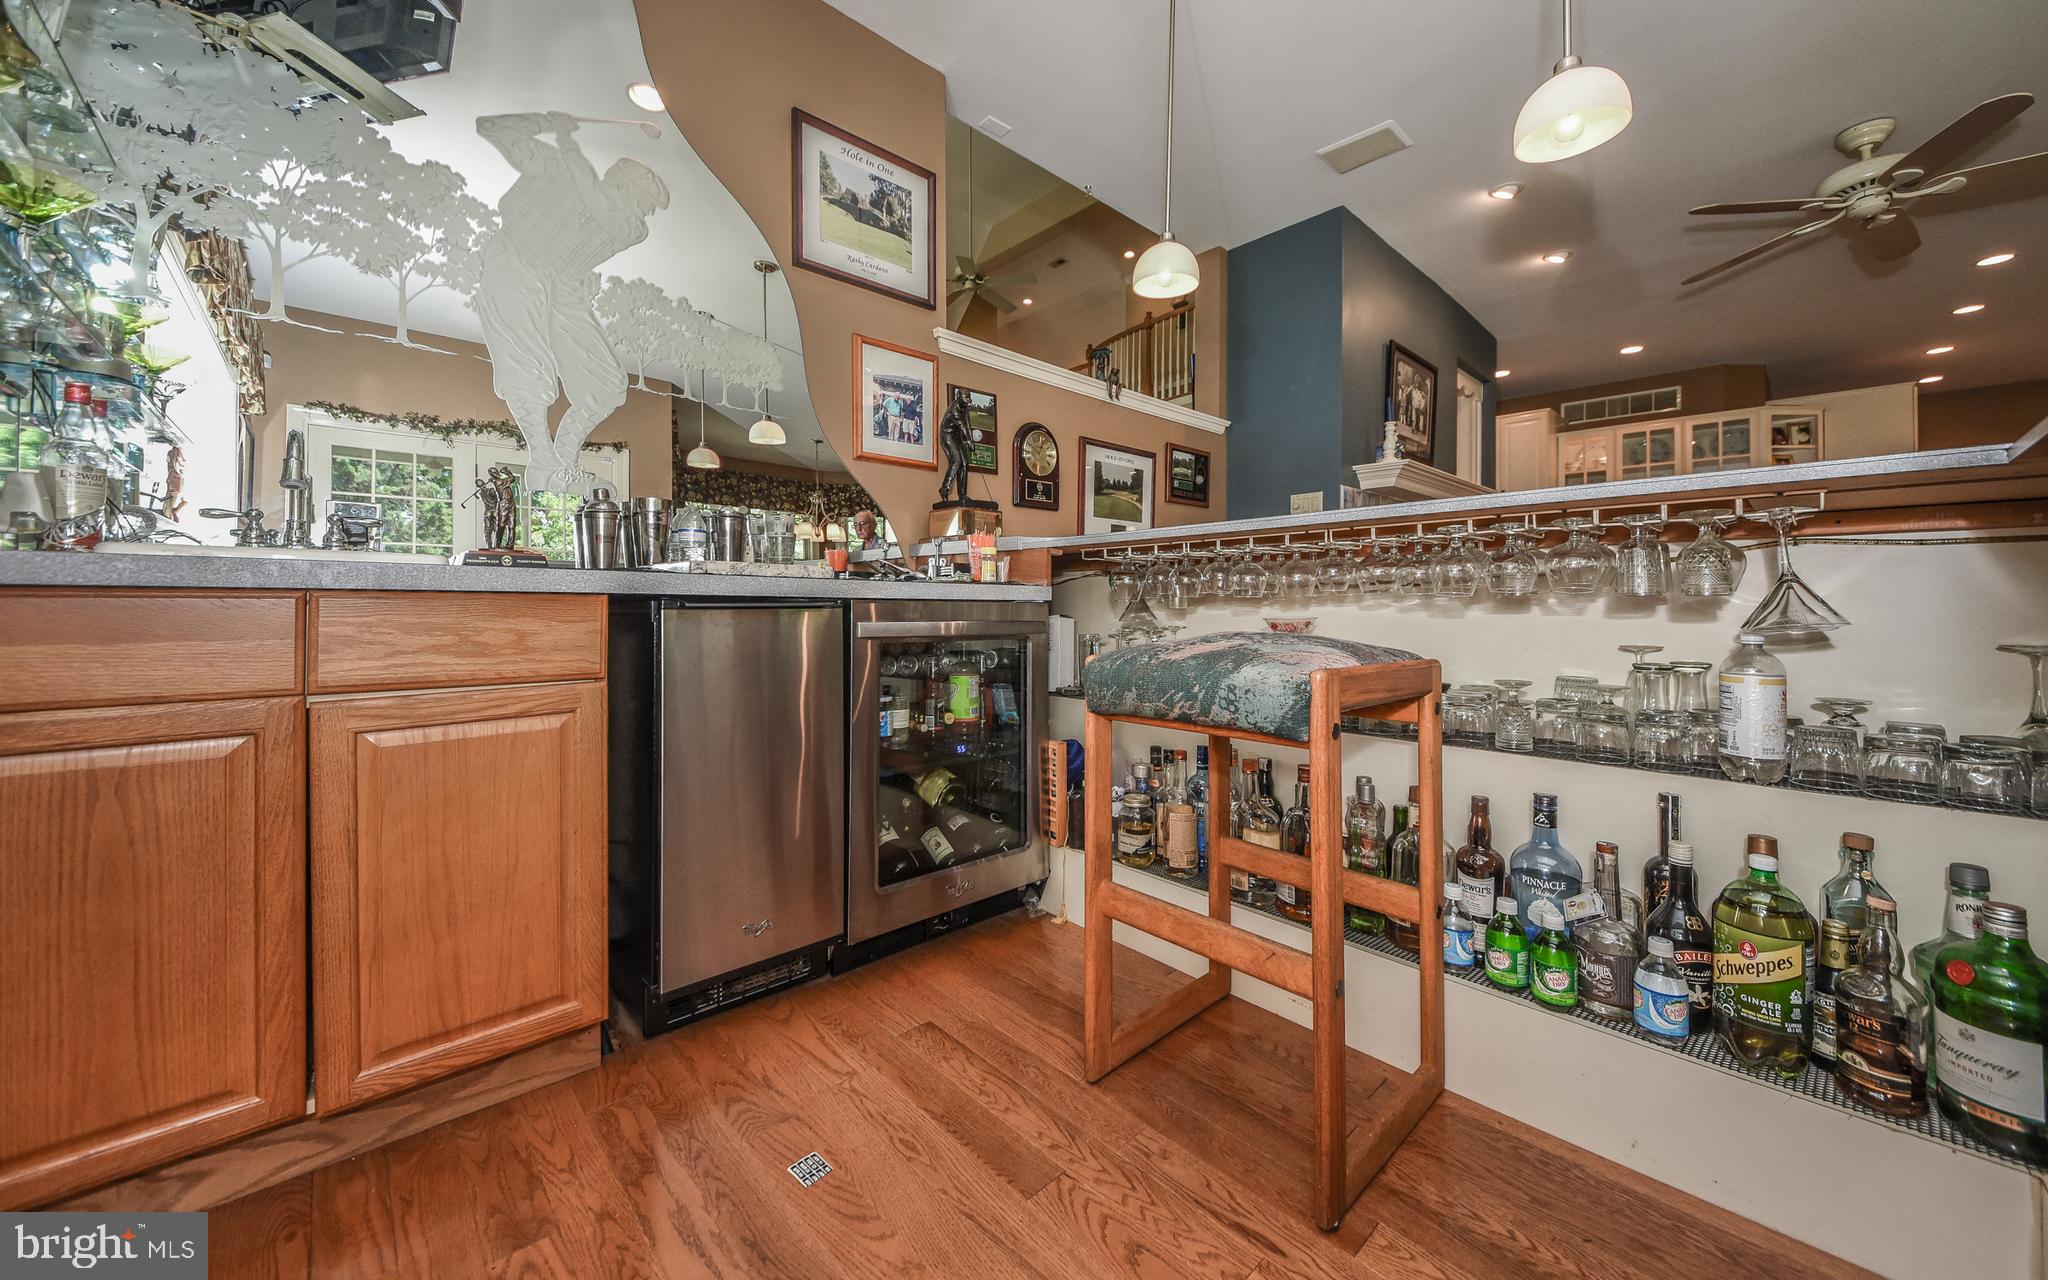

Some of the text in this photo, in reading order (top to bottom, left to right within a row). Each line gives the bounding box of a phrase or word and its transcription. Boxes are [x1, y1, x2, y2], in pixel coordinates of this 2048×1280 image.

[840, 146, 896, 177] Hole in One
[1522, 875, 1567, 891] PINNACLE
[1716, 956, 1793, 979] Schweppes
[1740, 994, 1782, 1010] GINGER
[1760, 1008, 1782, 1018] ALE
[1936, 1033, 2020, 1080] Tanqueray
[1948, 1060, 1993, 1083] IMPORTED
